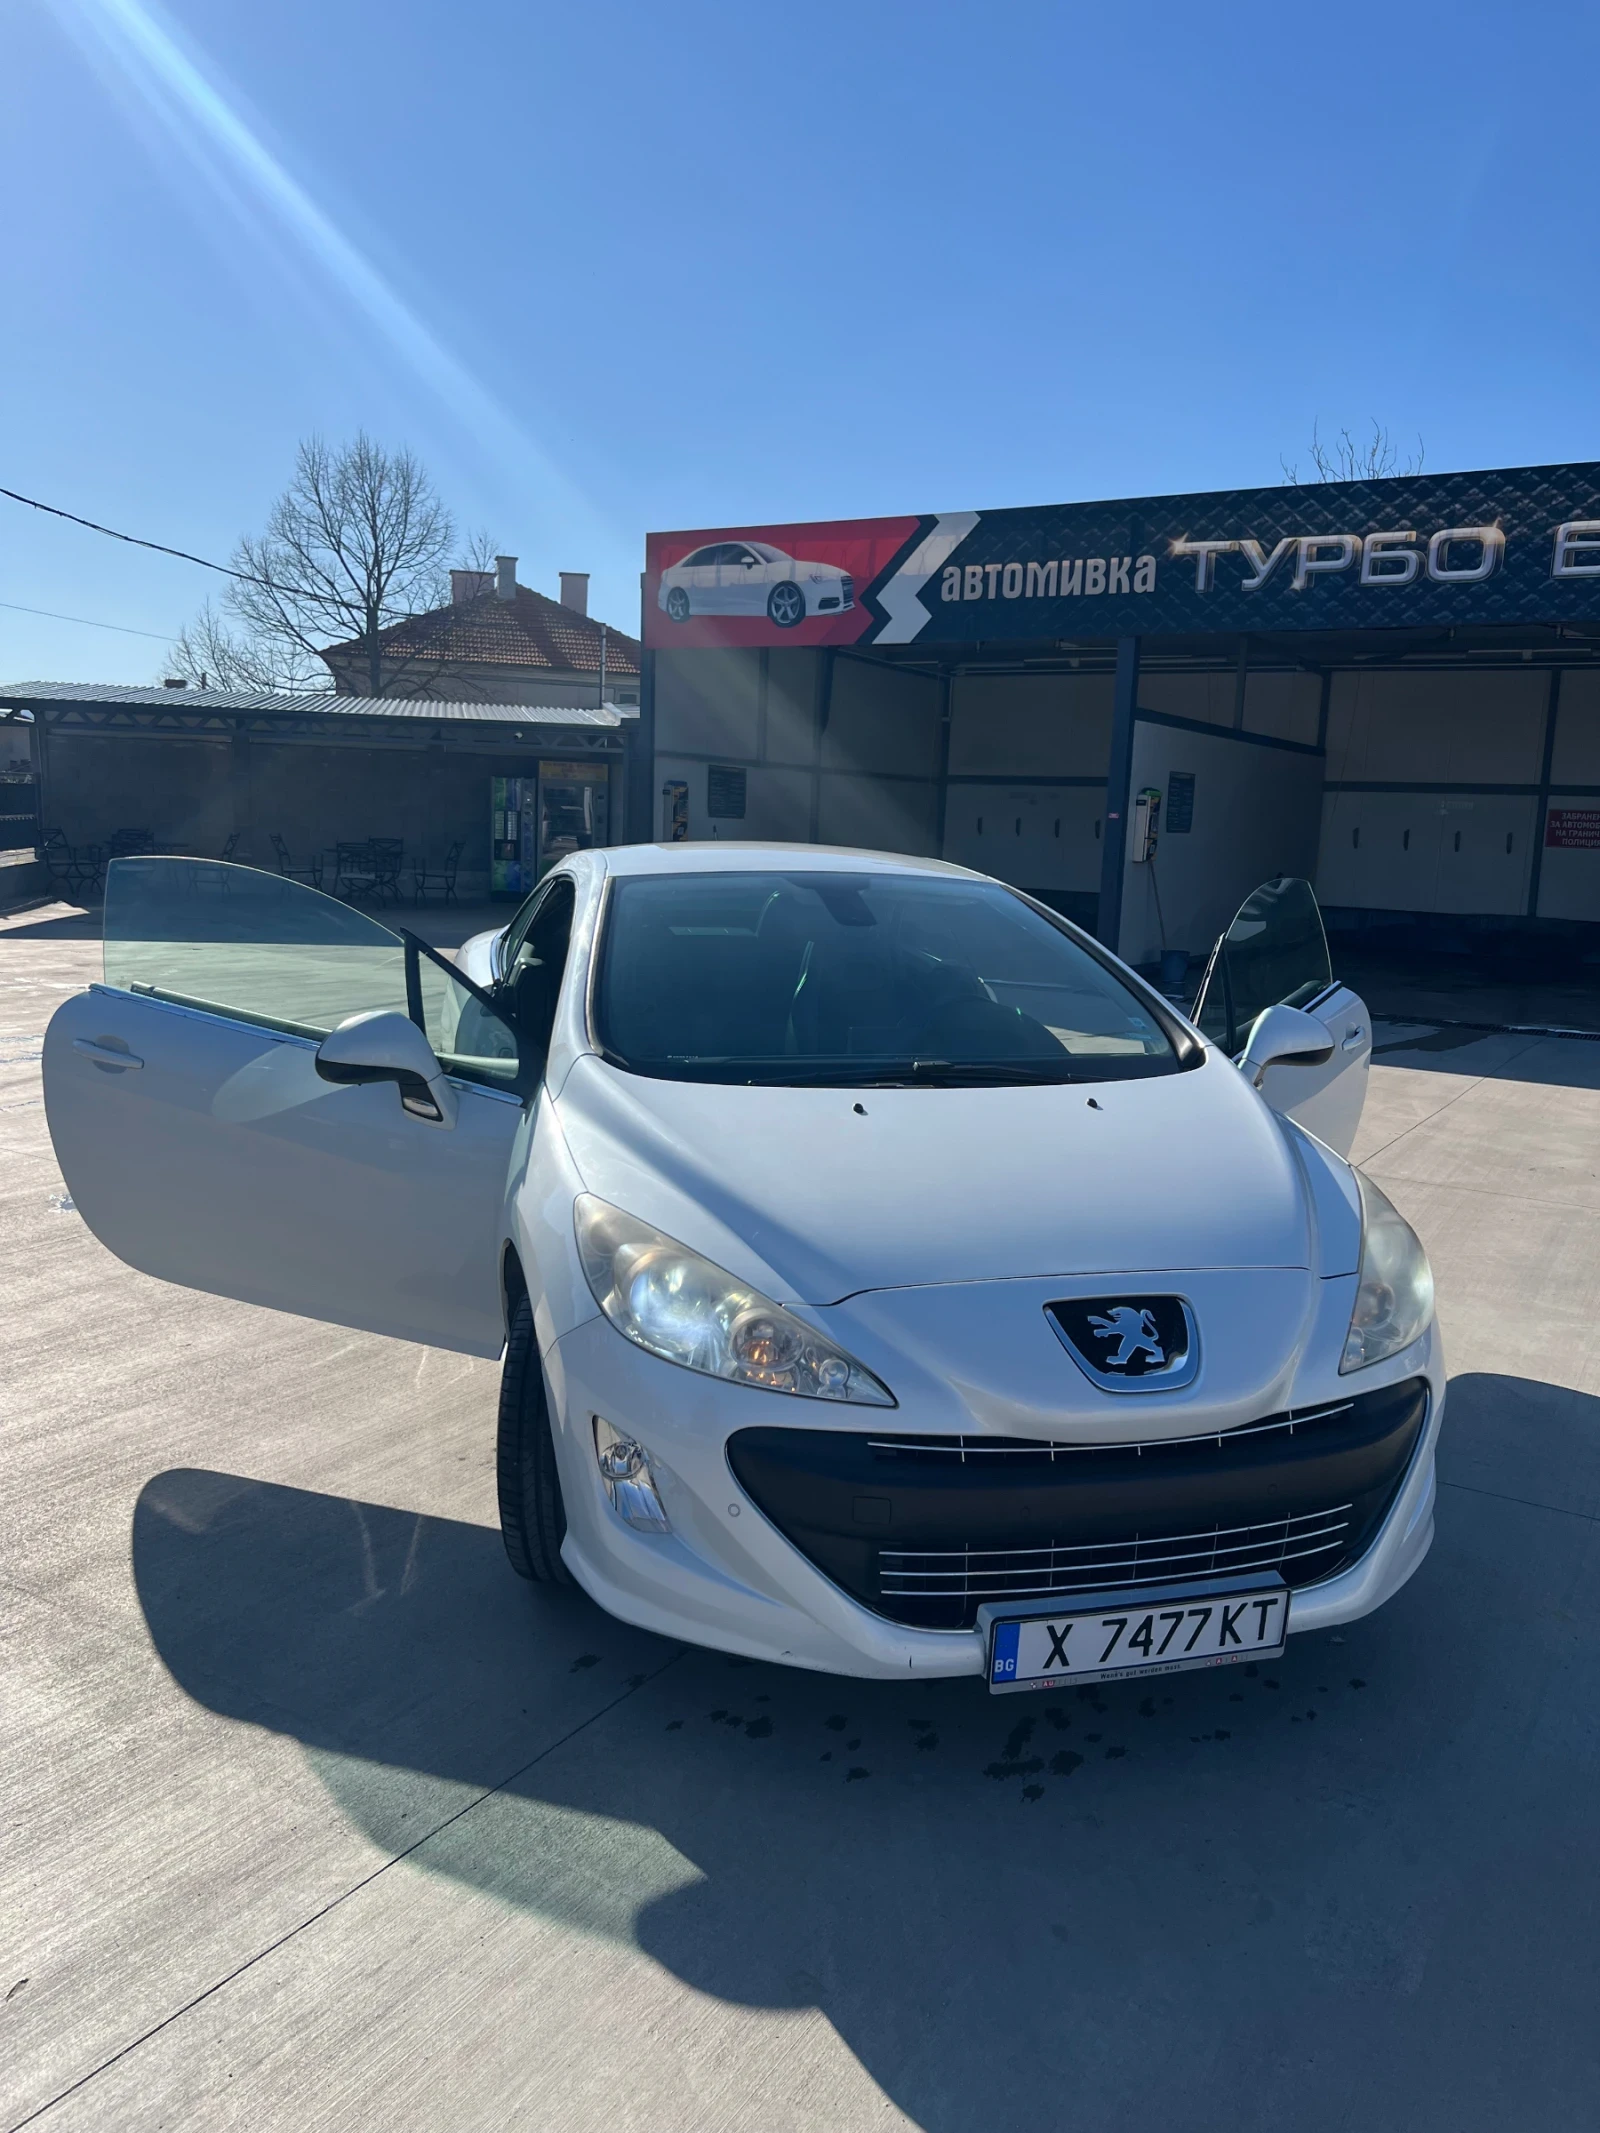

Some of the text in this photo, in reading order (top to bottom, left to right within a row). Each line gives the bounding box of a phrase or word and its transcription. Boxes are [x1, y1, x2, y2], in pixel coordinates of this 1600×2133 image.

[1170, 522, 1506, 593] ТУРБО
[1550, 820, 1561, 828] ЗА
[1042, 1623, 1074, 1669] X
[994, 1658, 1015, 1673] BG
